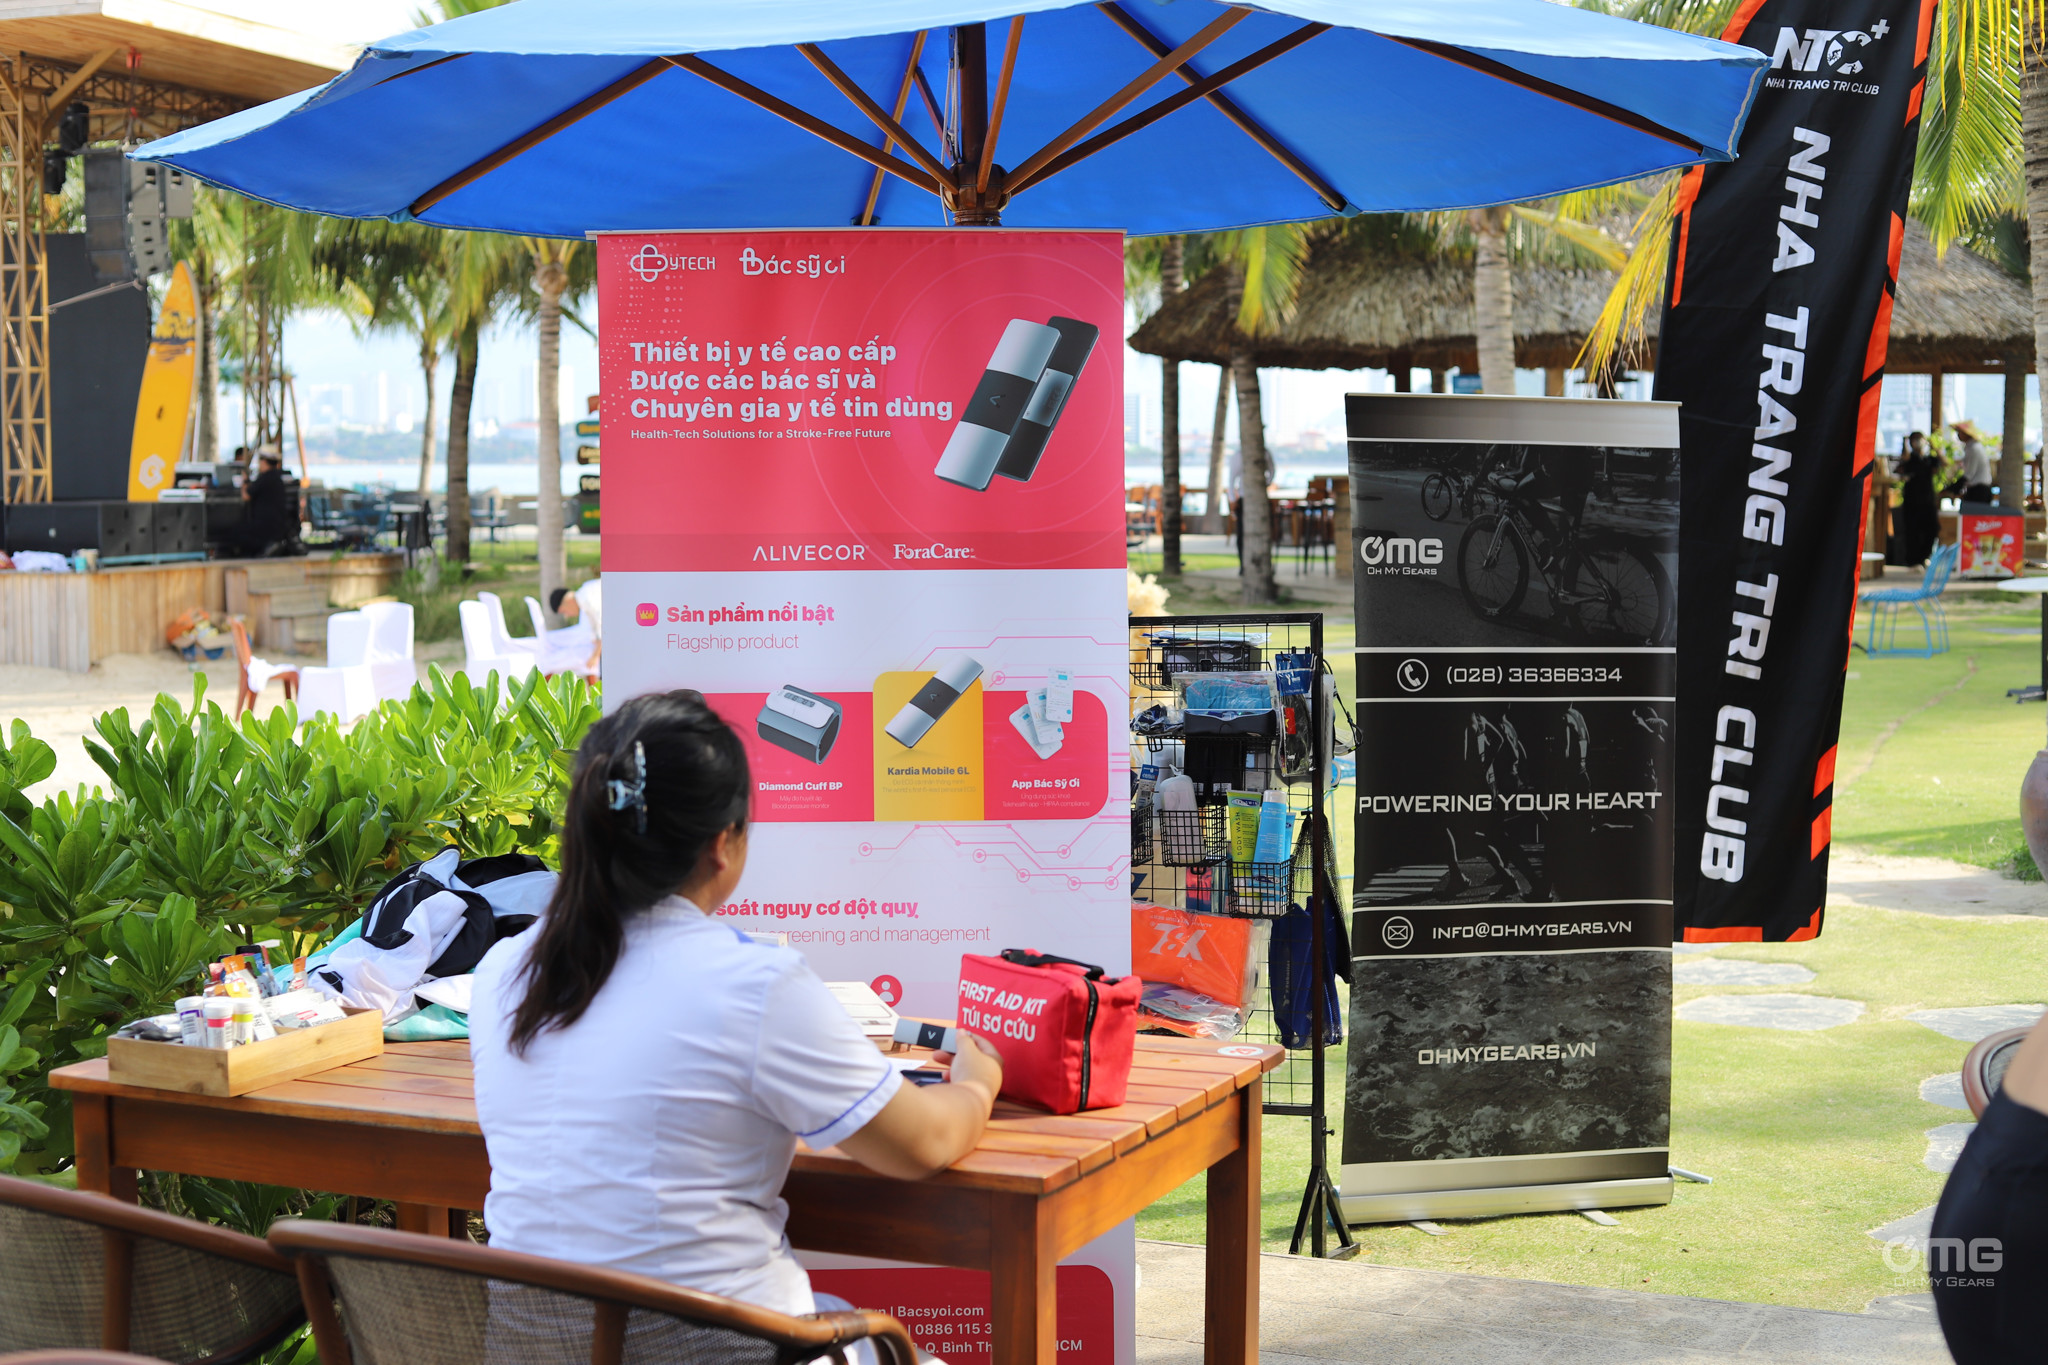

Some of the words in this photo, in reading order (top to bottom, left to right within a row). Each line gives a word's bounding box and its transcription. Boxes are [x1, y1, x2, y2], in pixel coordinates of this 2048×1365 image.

[1765, 77, 1785, 88] NHA
[1787, 79, 1830, 90] TRANG
[1833, 80, 1850, 92] TRI
[1851, 82, 1880, 95] CLUB
[1772, 126, 1831, 273] NHA
[630, 336, 699, 362] Thiết
[706, 340, 730, 368] bị
[737, 345, 753, 366] y
[760, 336, 787, 362] tế
[793, 345, 841, 362] cao
[848, 335, 897, 365] cấp
[630, 370, 700, 396] Được
[707, 368, 754, 390] các
[761, 368, 809, 390] bác
[816, 368, 839, 389] sĩ
[845, 368, 876, 389] và
[630, 396, 733, 422] Chuyên
[740, 396, 781, 422] gia
[787, 401, 803, 422] y
[809, 392, 837, 418] tế
[843, 396, 879, 418] tin
[885, 396, 953, 422] dùng
[631, 429, 700, 439] Health-Tech
[702, 429, 755, 439] Solutions
[758, 429, 773, 439] for
[776, 431, 783, 439] a
[786, 428, 852, 438] Stroke-Free
[855, 428, 891, 438] Future
[1742, 305, 1810, 547] TRANG
[667, 605, 705, 623] Sản
[708, 601, 764, 626] phẩm
[768, 601, 798, 622] nổi
[802, 604, 835, 626] bật
[1725, 573, 1779, 680] TRI
[667, 633, 734, 653] Flagship
[737, 634, 800, 653] product
[1446, 666, 1503, 685] (028)
[1508, 668, 1623, 683] 36366334
[887, 766, 920, 775] Kardia
[921, 766, 955, 775] Mobile
[759, 781, 804, 791] Diamond
[804, 781, 828, 791] Cuff
[828, 781, 843, 791] BP
[1011, 779, 1033, 789] App
[1033, 778, 1053, 788] Bác
[1054, 778, 1068, 789] Sỹ
[1700, 704, 1757, 884] CLUB
[1359, 794, 1493, 814] POWERING
[1497, 793, 1570, 811] YOUR
[1576, 791, 1662, 810] HEART
[762, 902, 812, 919] nguy
[816, 900, 841, 916] cơ
[844, 898, 878, 919] đột
[881, 901, 919, 919] quỵ
[769, 928, 845, 945] reening
[850, 926, 880, 943] and
[884, 926, 990, 945] management
[1432, 920, 1632, 939] INFO@OHMYGEARS.VN
[959, 979, 992, 1005] FIRST
[992, 989, 1023, 1011] AID
[1022, 996, 1047, 1017] KIT
[962, 1006, 980, 1027] TÚI
[1003, 1017, 1036, 1043] CỨU
[1418, 1042, 1596, 1065] OHMYGEARS.VN
[897, 1305, 985, 1319] Bacsyoi.com
[914, 1323, 953, 1335] 0886
[957, 1323, 981, 1335] 115
[925, 1342, 939, 1354] Q.
[942, 1341, 973, 1353] Bình
